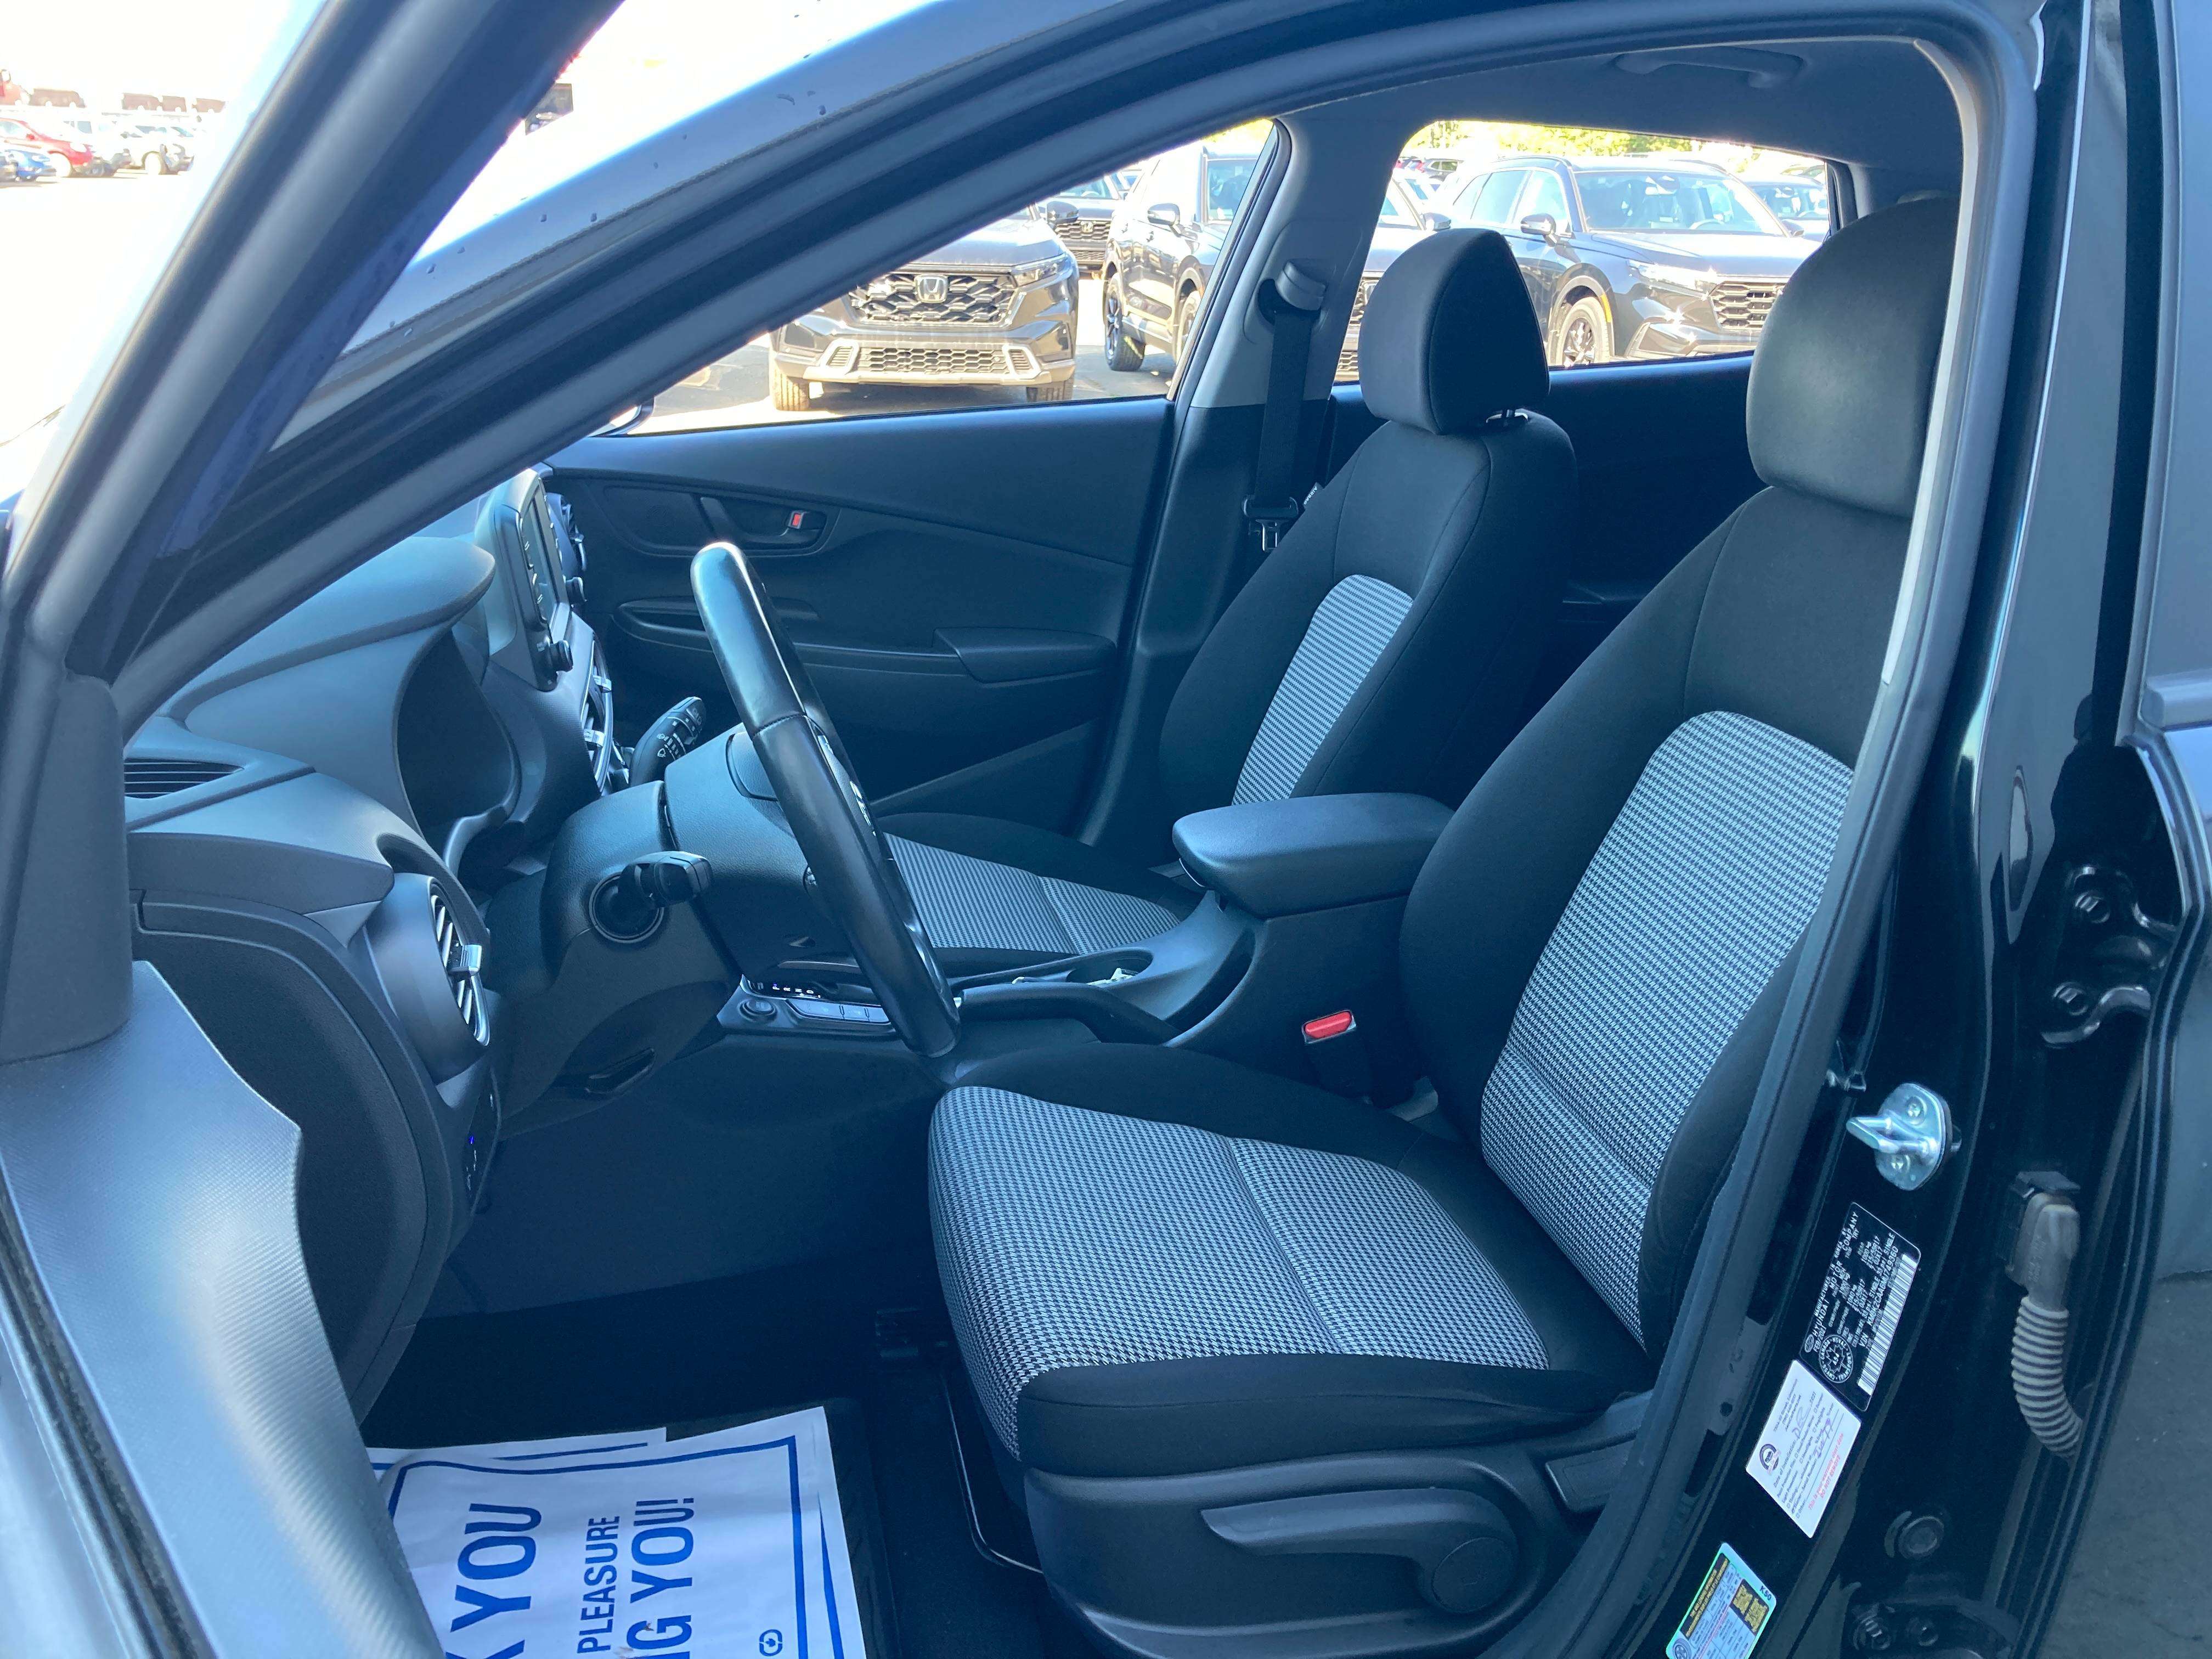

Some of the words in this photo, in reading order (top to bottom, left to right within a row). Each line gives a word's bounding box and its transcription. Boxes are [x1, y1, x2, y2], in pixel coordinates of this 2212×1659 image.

[1813, 1299, 1829, 1337] HYUNDAI
[1829, 1260, 1842, 1289] MOTOR
[1842, 1211, 1859, 1251] COMPANY
[1814, 1276, 1831, 1317] MANUFACTURED
[1833, 1240, 1842, 1258] KOREA
[1813, 1324, 1826, 1352] FEB/2021
[1859, 1333, 1868, 1348] VIN
[450, 1502, 543, 1633] YOU
[576, 1515, 620, 1654] PLEASURE
[629, 1497, 695, 1604] YOU!
